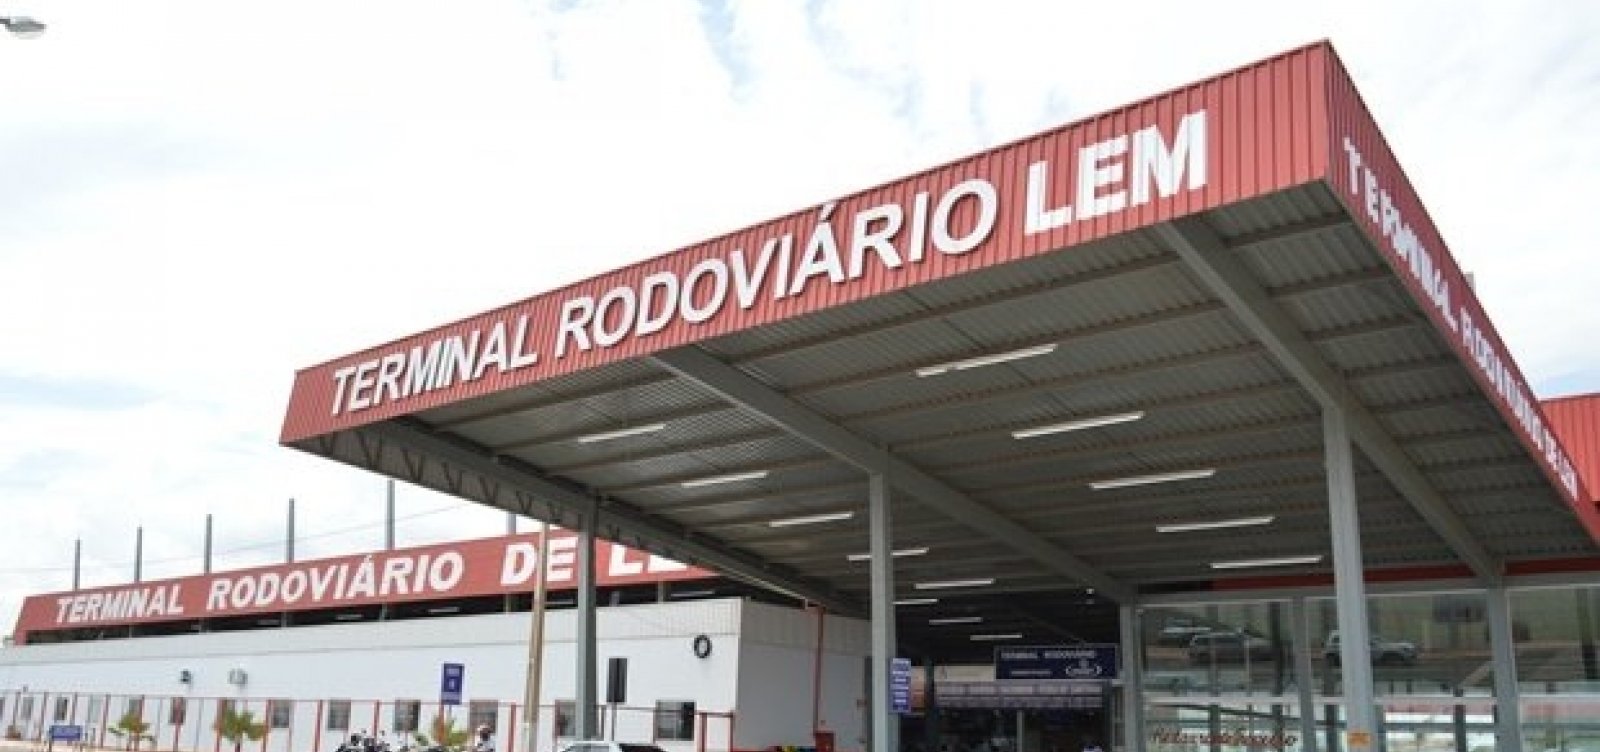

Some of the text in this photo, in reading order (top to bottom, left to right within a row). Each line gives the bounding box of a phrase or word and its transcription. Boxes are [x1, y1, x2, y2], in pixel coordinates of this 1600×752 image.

[331, 109, 1208, 415] TERMINAL RODOVIÁRIO LEM
[1344, 137, 1458, 333] TERMINAL
[55, 583, 184, 624] TERMINAL
[206, 552, 465, 611] RODOVIÁRIO
[500, 536, 578, 586] DE
